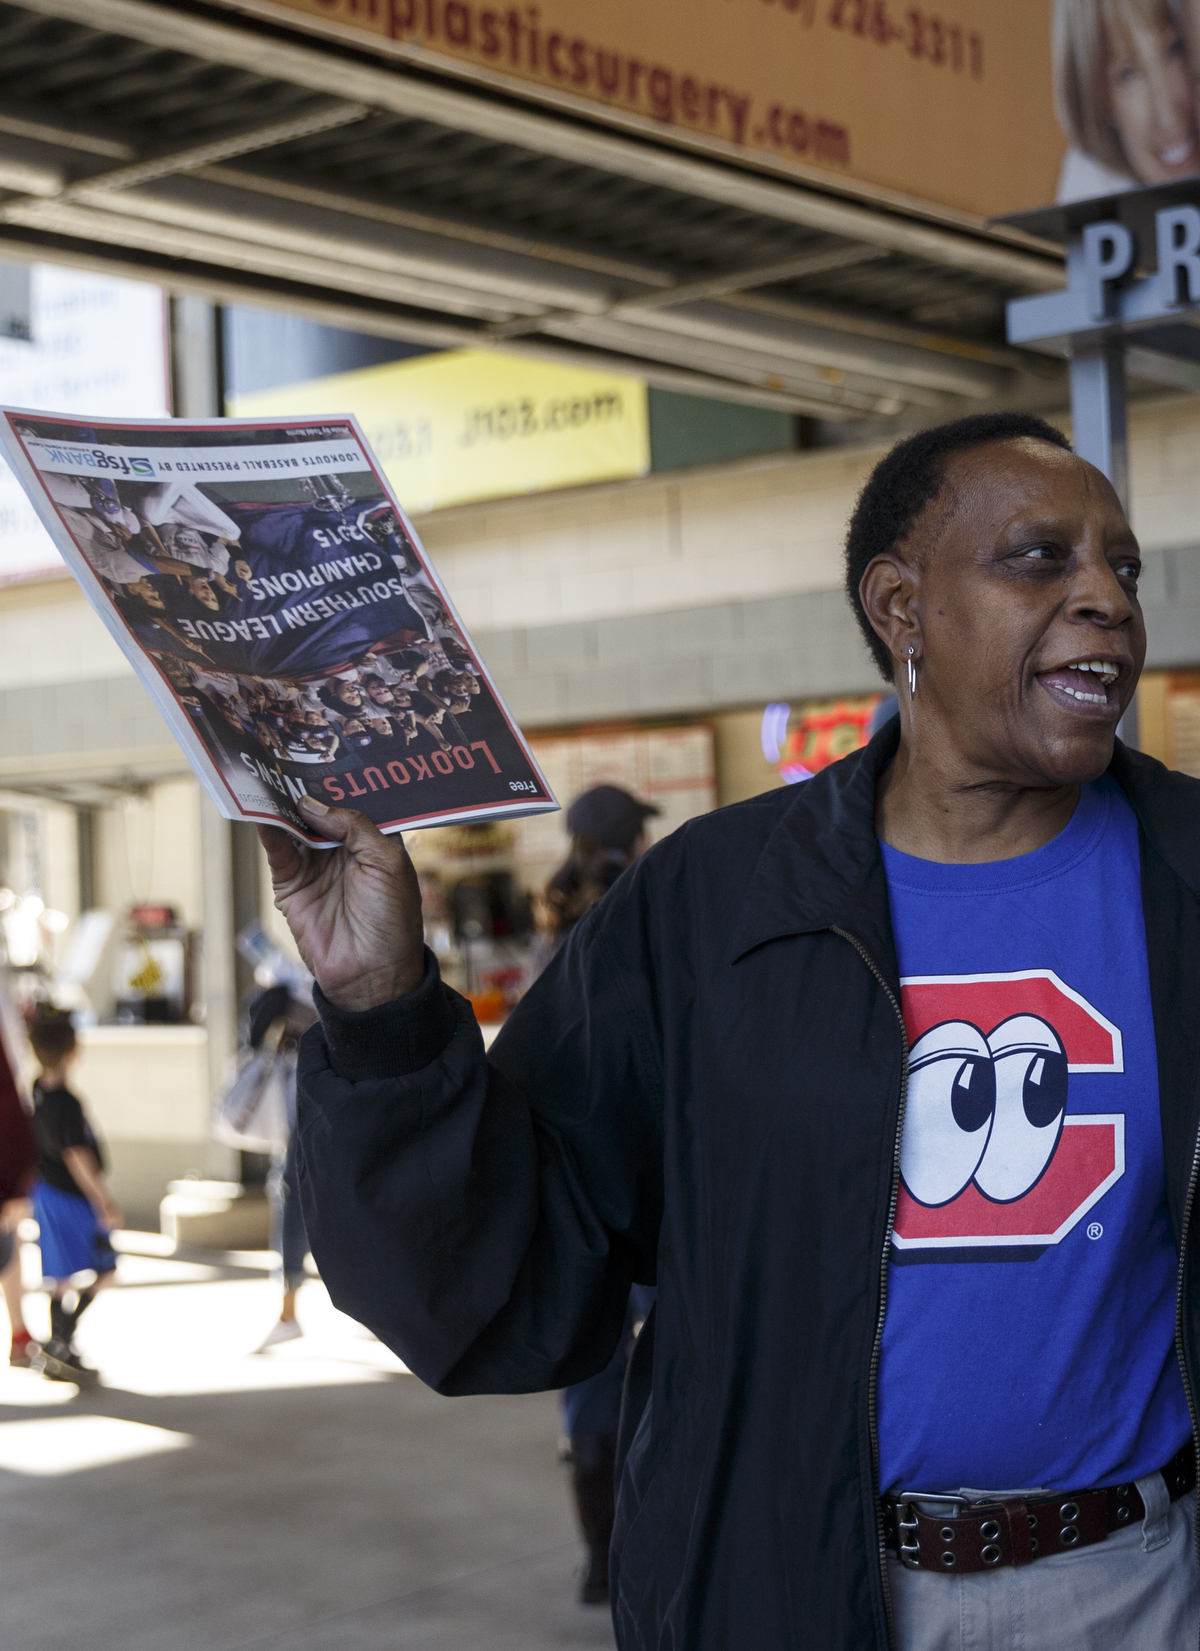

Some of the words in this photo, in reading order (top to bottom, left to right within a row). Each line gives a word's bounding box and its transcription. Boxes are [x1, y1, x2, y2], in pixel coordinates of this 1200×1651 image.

[158, 462, 171, 471] BY
[176, 461, 239, 472] PRESENTED
[242, 458, 299, 471] BASEBALL
[302, 452, 360, 466] LOOKOUTS
[312, 525, 364, 548] 2015
[247, 552, 382, 601] CHAMPIONS
[282, 578, 403, 630] SOUTHERN
[177, 614, 282, 643] LEAGUE
[240, 752, 307, 805] NEWS
[323, 740, 502, 801] LOOKOUTS
[509, 780, 538, 794] Free
